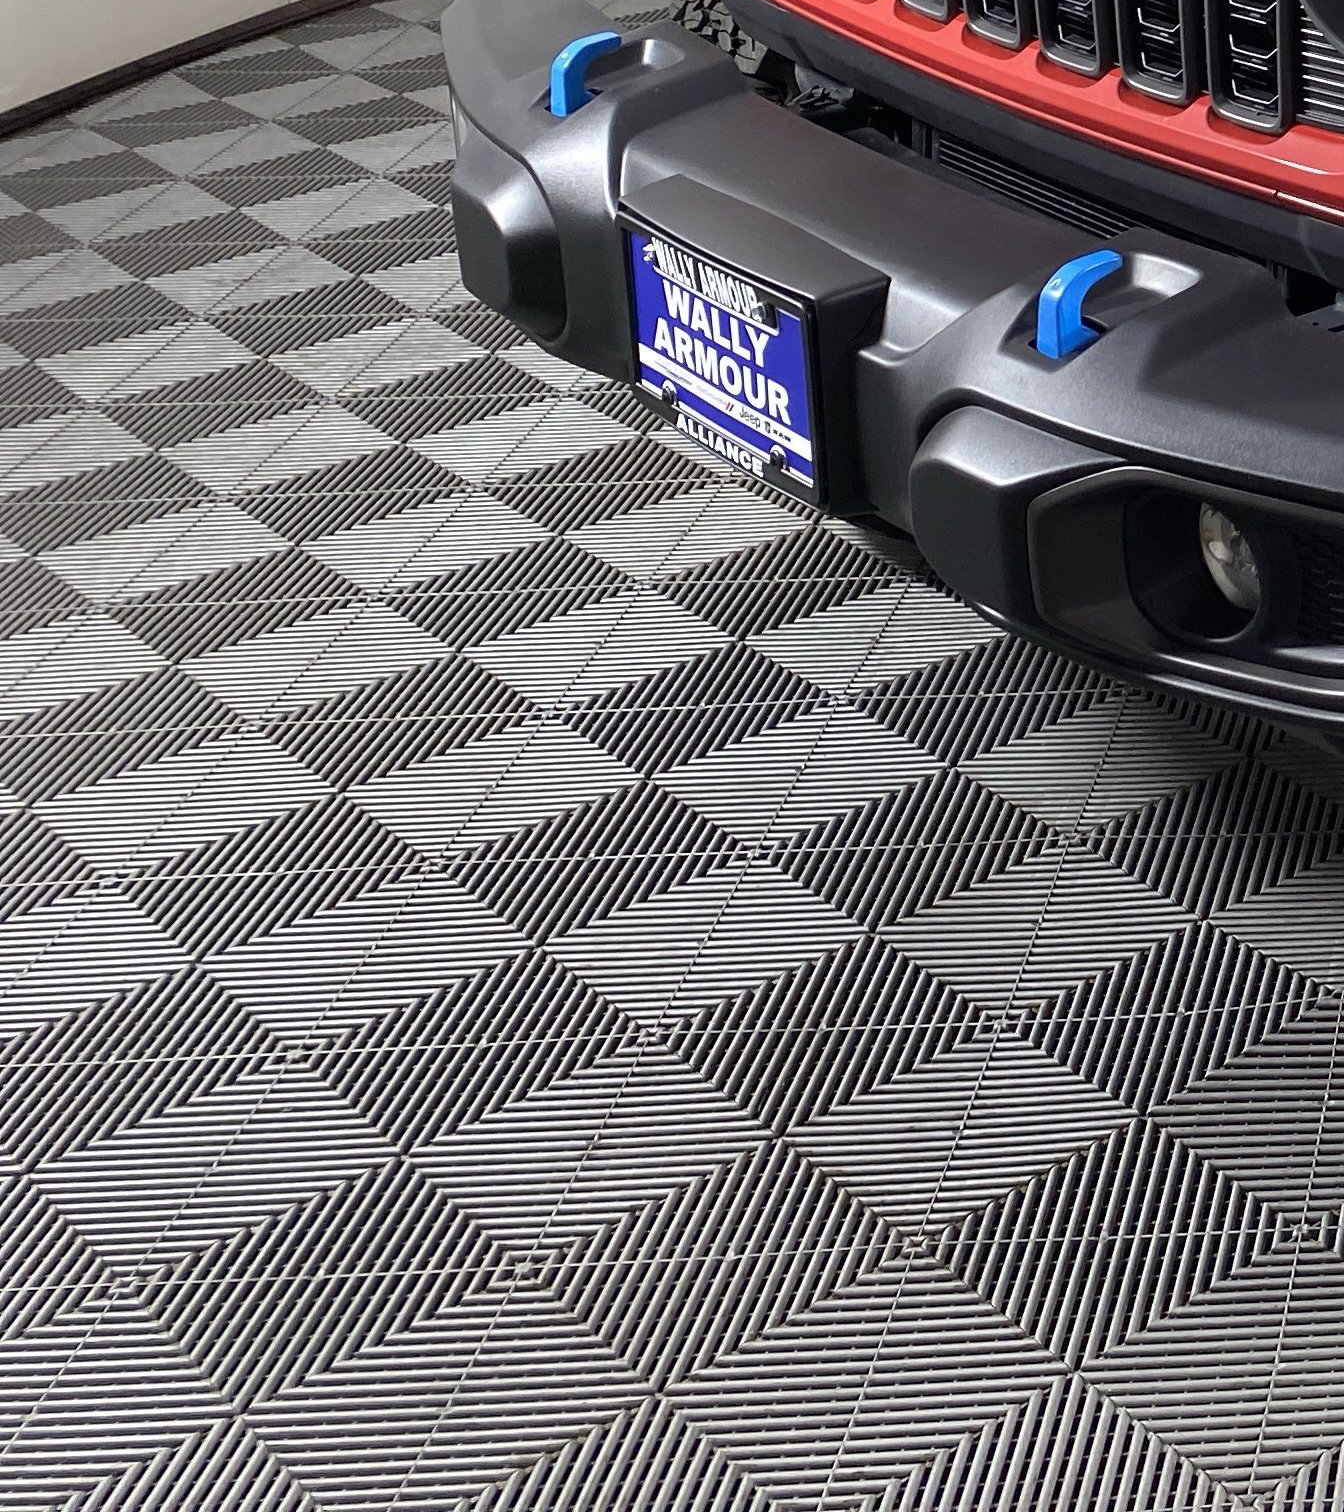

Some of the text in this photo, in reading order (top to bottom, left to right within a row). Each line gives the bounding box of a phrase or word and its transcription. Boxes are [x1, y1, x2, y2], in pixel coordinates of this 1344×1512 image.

[652, 237, 698, 289] WALLY
[661, 279, 770, 368] WALLY
[653, 317, 791, 426] ARMOUR
[675, 413, 765, 478] ALLIANCE
